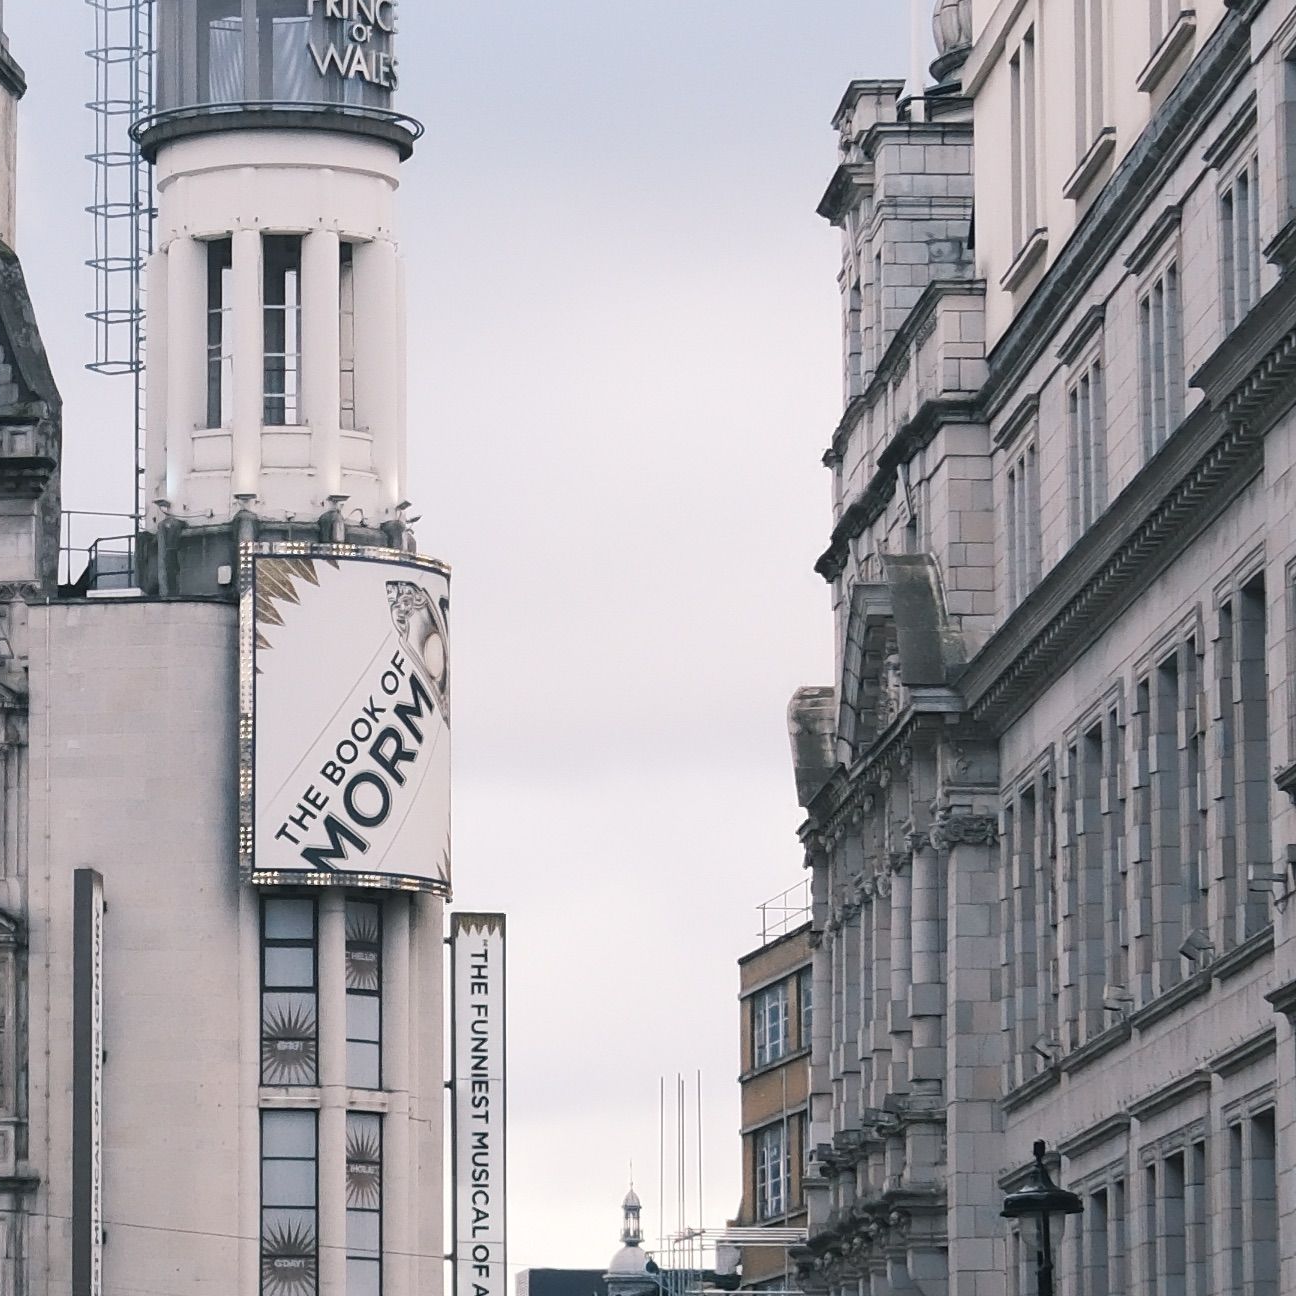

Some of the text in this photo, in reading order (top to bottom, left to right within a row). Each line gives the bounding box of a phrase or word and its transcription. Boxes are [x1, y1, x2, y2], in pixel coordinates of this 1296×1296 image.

[306, 42, 399, 91] WALES
[352, 23, 373, 43] OF
[274, 649, 406, 845] THE BOOK OF
[300, 669, 436, 871] MORM
[470, 1004, 489, 1124] FUNNIEST
[471, 1132, 490, 1238] MUSICAL
[472, 1245, 490, 1278] OF
